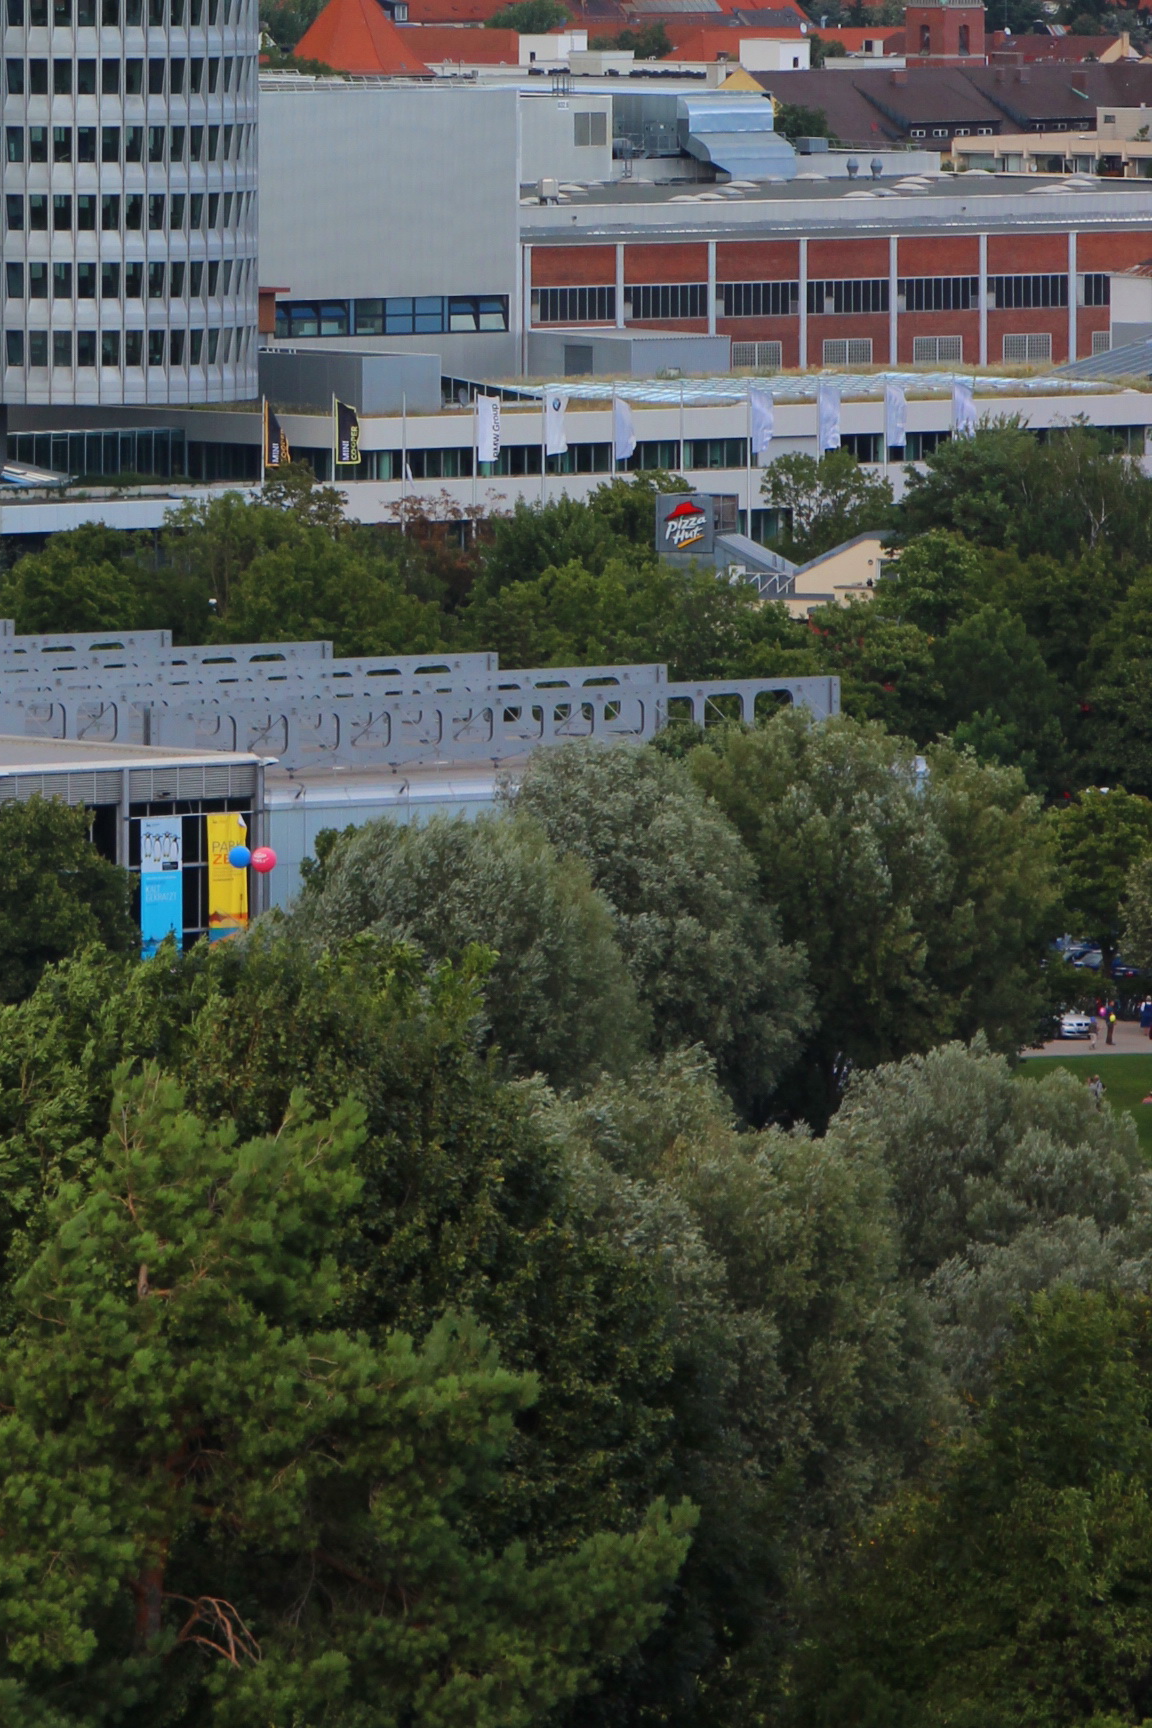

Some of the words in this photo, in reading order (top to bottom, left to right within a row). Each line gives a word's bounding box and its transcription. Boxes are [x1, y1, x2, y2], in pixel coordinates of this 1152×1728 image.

[491, 403, 500, 432] Group
[350, 425, 358, 460] COOPER
[665, 515, 706, 540] Pizza
[673, 526, 703, 544] Hut
